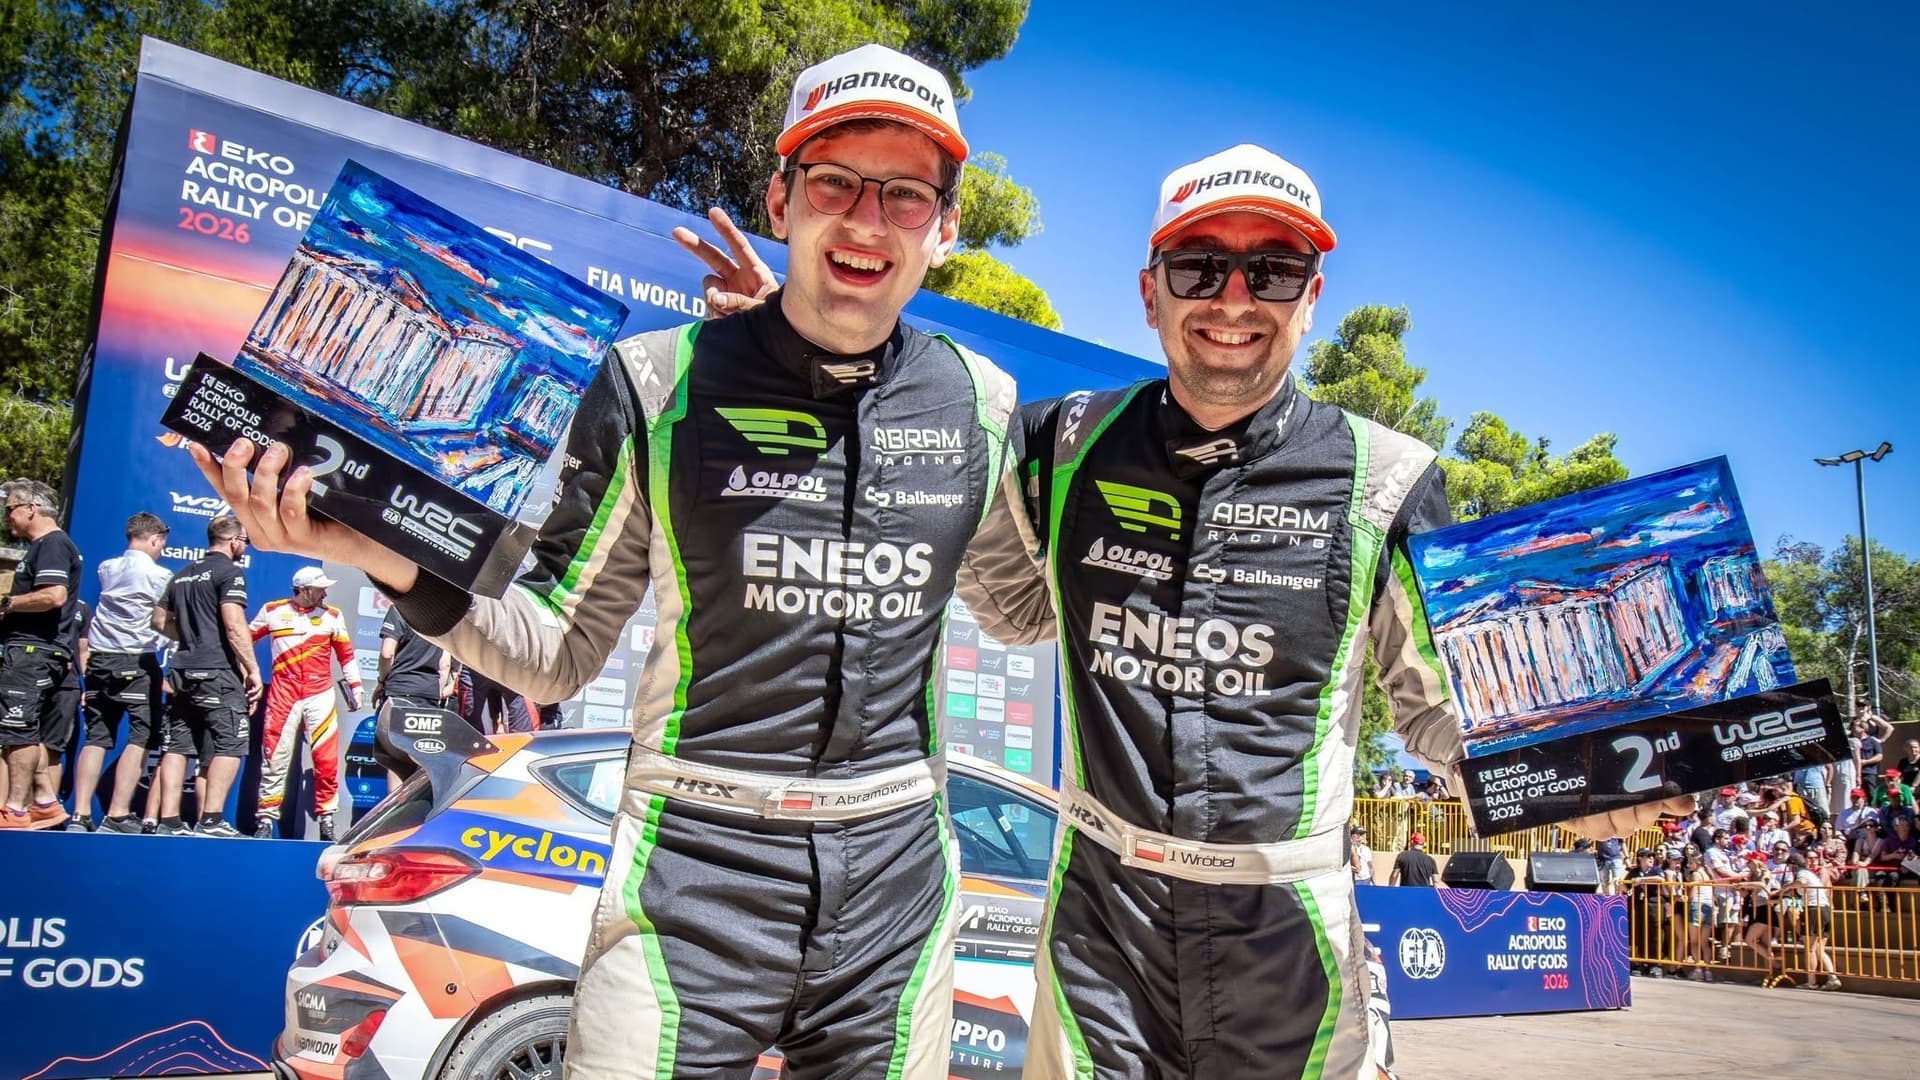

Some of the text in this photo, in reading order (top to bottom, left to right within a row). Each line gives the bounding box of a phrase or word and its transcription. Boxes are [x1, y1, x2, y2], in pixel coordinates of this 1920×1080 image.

[221, 140, 295, 175] EKO
[181, 179, 313, 231] RALLY OF
[177, 207, 250, 244] 2026
[587, 266, 707, 318] FIA WORLD
[214, 381, 246, 403] EKO
[188, 396, 226, 422] RALLY
[224, 416, 243, 431] OF
[195, 386, 262, 427] ACROPOLIS
[181, 409, 213, 432] 2026
[873, 428, 961, 450] ABRAM
[311, 434, 371, 497] 2nd
[875, 454, 962, 465] RACING
[751, 471, 827, 493] OLPOL
[895, 491, 963, 508] Balhanger
[390, 484, 483, 548] WRC
[1211, 502, 1329, 530] ABRAM
[1208, 530, 1326, 549] RACING
[743, 533, 933, 587] ENEOS
[1106, 545, 1174, 572] OLPOL
[1233, 569, 1321, 590] Balhanger
[743, 583, 923, 619] MOTOR OIL
[1089, 601, 1275, 668] ENEOS
[1090, 649, 1272, 696] MOTOR OIL
[405, 716, 442, 731] OMP
[1713, 703, 1823, 745] WRC
[416, 740, 443, 750] BELL
[1721, 747, 1743, 761] FIA
[1747, 737, 1825, 758] CHAMPIONSHIP
[1493, 763, 1528, 779] EKO
[1612, 731, 1681, 793] 2nd
[672, 776, 738, 799] HRX
[836, 778, 918, 806] Abramowski
[1484, 768, 1558, 795] ACROPOLIS
[1485, 776, 1587, 807] RALLY OF GODS
[1069, 801, 1106, 833] HRX
[1489, 804, 1524, 821] 2026
[460, 827, 606, 876] cyclon
[1181, 851, 1236, 868] Wróbel
[986, 922, 1012, 932] RALLY
[1012, 924, 1024, 934] OF
[987, 914, 1033, 925] ACROPOLIS
[1538, 917, 1566, 931] EKO
[1508, 935, 1567, 951] ACROPOLIS
[23, 958, 145, 988] GODS
[1487, 953, 1568, 970] RALLY OF GODS
[1543, 973, 1568, 990] 2026
